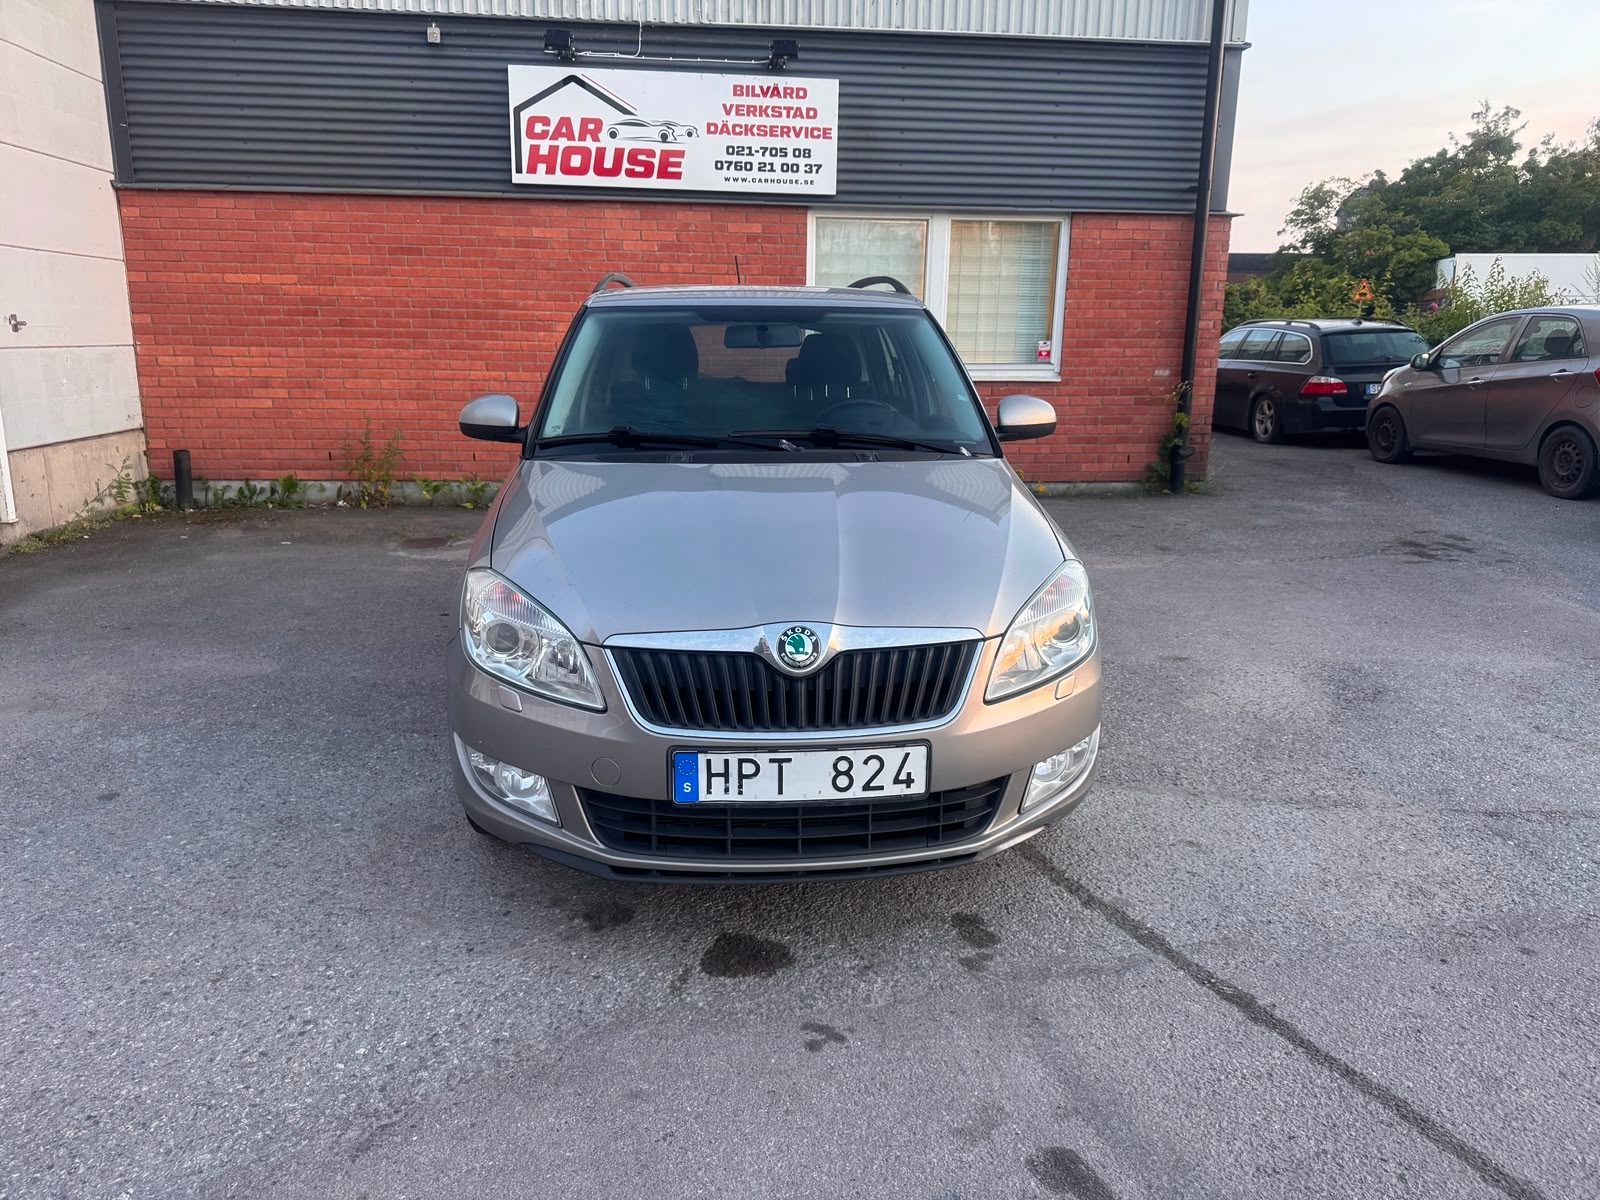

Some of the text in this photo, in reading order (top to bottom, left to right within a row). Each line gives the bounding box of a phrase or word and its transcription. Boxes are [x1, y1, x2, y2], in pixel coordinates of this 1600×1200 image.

[732, 83, 808, 100] BILVÅRD
[722, 103, 818, 120] VERKSTAD
[525, 115, 604, 142] CAR
[706, 120, 833, 140] DÄCKSERVICE
[725, 145, 812, 159] 021-705 08
[526, 144, 686, 180] HOUSE
[714, 160, 823, 174] 0760 21 00 37
[723, 176, 815, 185] WWW.CARHOUSE.SE
[705, 752, 915, 795] HPT 824
[683, 782, 692, 793] S
